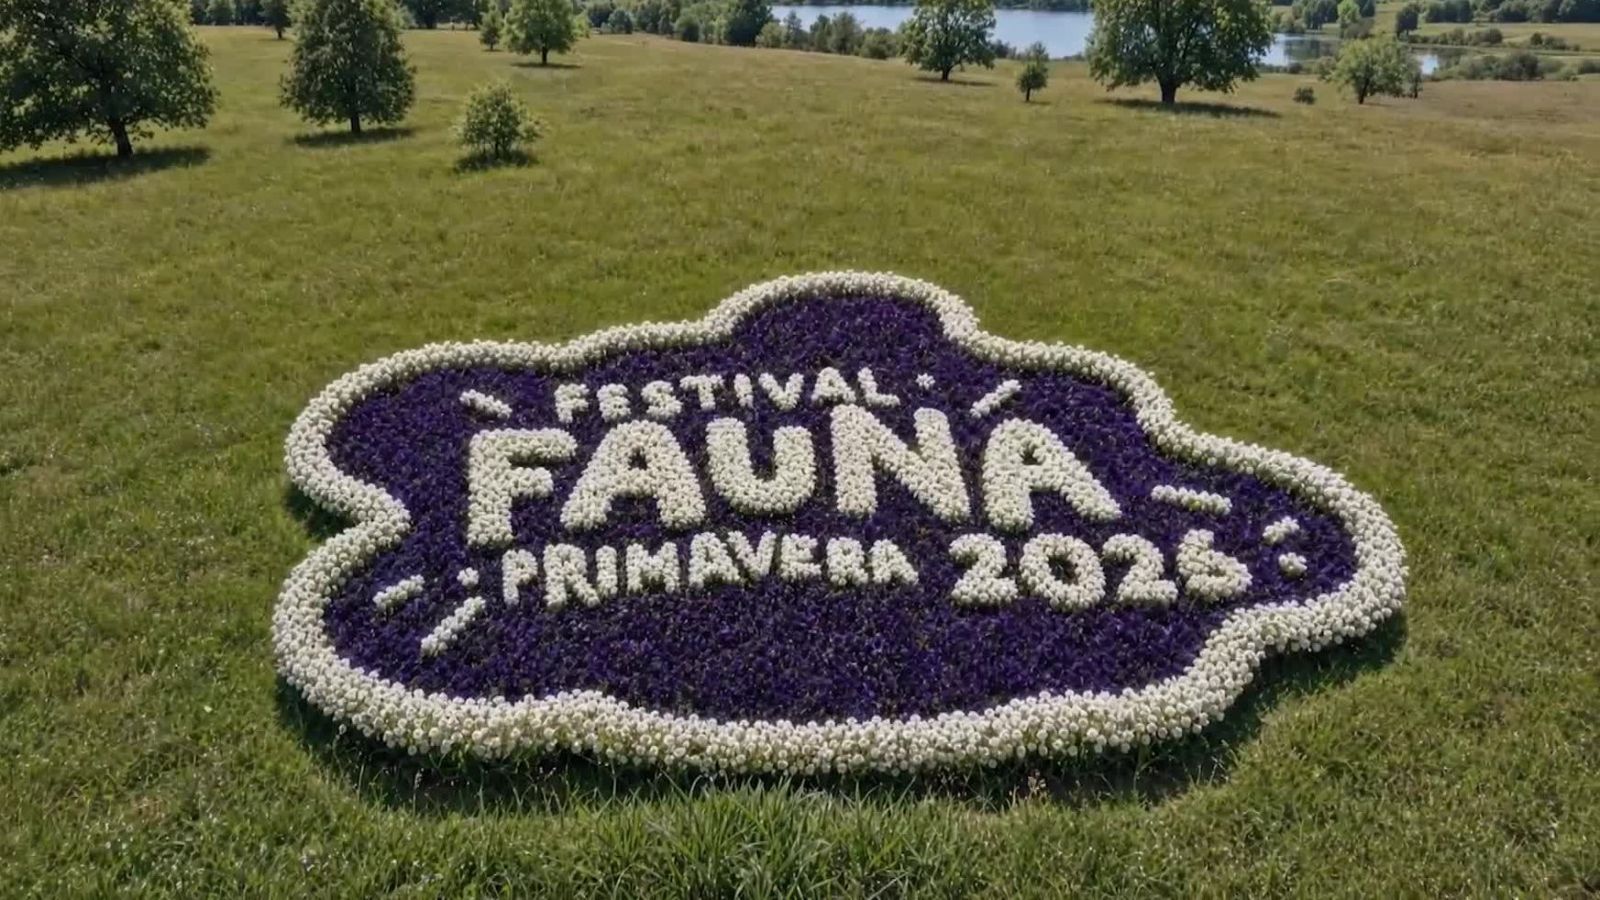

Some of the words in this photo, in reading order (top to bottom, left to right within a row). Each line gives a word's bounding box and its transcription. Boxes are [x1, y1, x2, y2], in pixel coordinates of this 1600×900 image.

[554, 366, 899, 424] FESTIVAL
[466, 403, 1121, 547] FAUNA
[502, 531, 919, 609] PRIMAVERA
